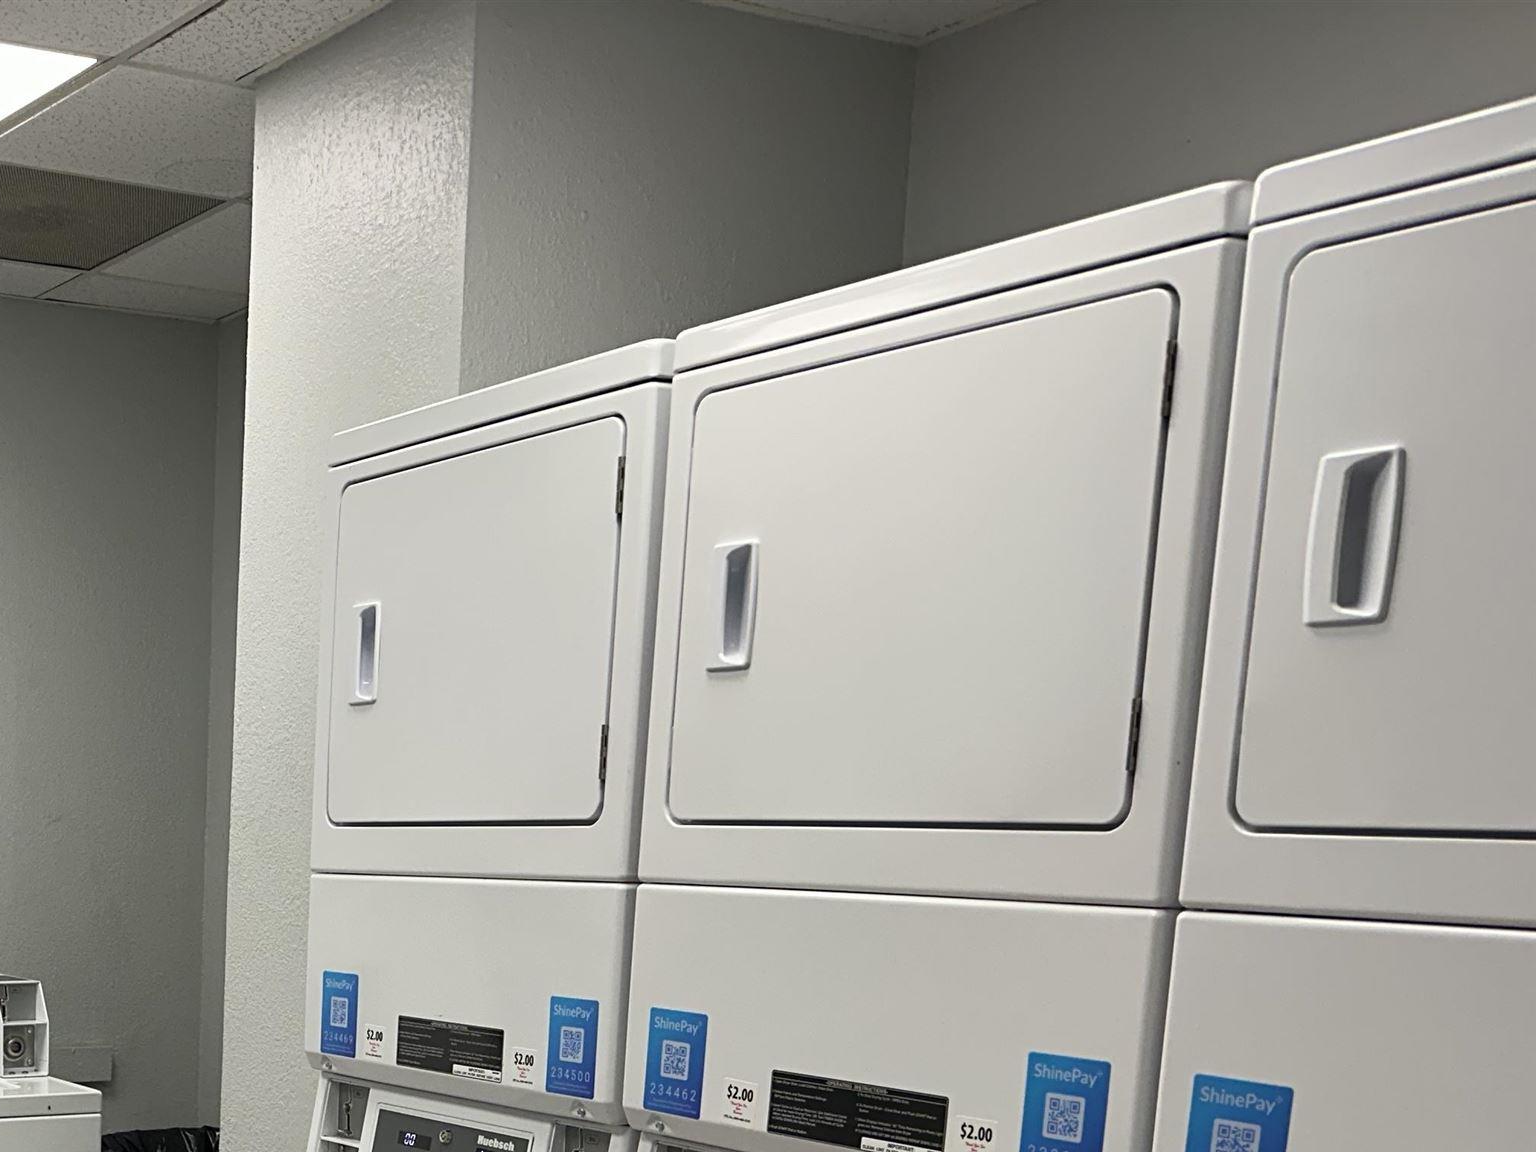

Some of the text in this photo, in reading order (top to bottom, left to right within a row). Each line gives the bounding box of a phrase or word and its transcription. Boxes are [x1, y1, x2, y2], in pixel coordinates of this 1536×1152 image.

[554, 1004, 592, 1021] ShinePay
[366, 1028, 384, 1042] $2.00
[654, 1015, 699, 1036] ShinePay
[514, 1052, 534, 1067] $2.00
[551, 1065, 591, 1082] 234500
[1034, 1063, 1098, 1088] ShinePay
[650, 1082, 697, 1102] 234462
[727, 1084, 754, 1103] $2.00
[1199, 1085, 1276, 1116] ShinePay
[960, 1122, 993, 1143] $2.00
[477, 1134, 515, 1152] Huebsch
